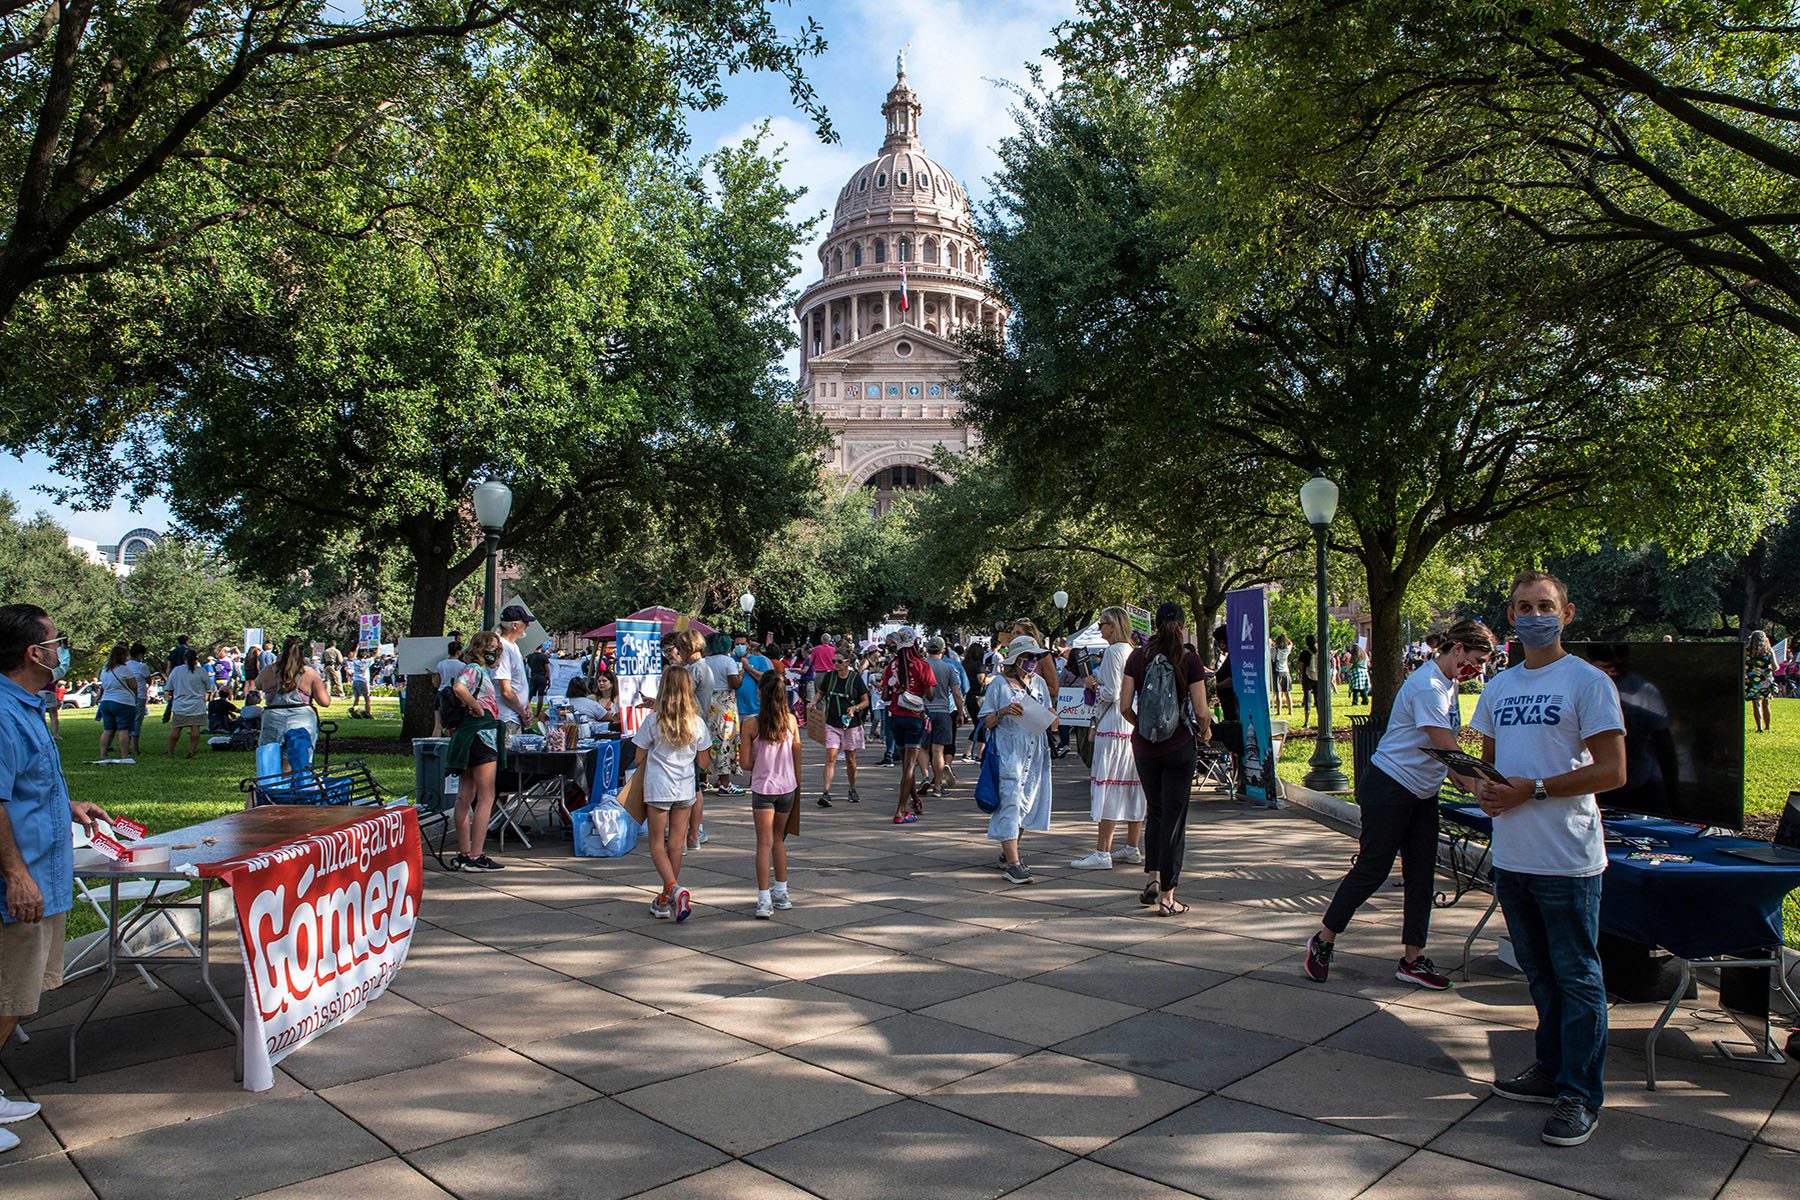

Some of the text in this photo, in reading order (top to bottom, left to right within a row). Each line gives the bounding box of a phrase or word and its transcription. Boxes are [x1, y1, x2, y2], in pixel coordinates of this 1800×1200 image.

[635, 639, 661, 657] SAFE
[620, 656, 661, 675] STORAGE
[1062, 705, 1077, 715] SAFE
[1504, 695, 1551, 707] TRUTH BY
[1494, 705, 1561, 726] TEXAS
[305, 811, 405, 872] Margaret
[248, 861, 414, 1016] Gómez
[266, 976, 377, 1055] ommissioner
